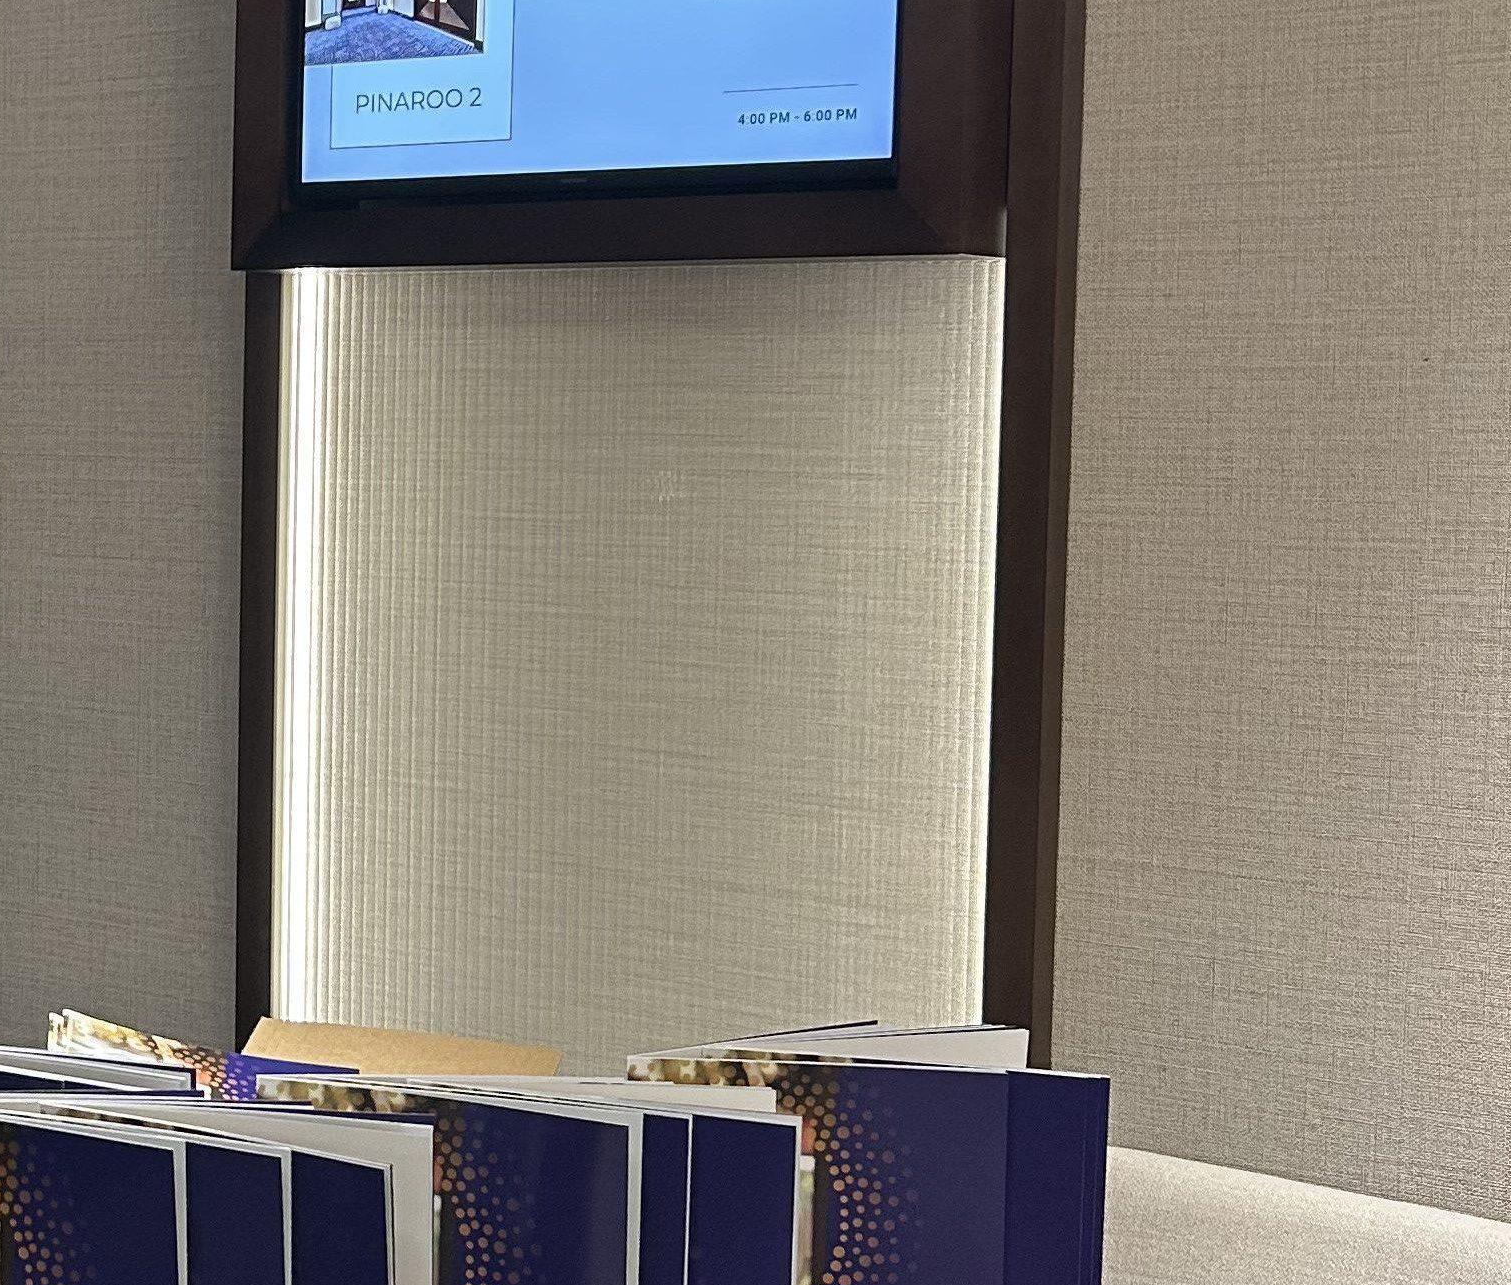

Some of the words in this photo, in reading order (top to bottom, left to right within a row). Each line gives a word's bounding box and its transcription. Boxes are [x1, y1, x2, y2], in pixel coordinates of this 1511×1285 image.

[355, 88, 463, 115] PINAROO
[469, 87, 483, 107] 2
[769, 111, 790, 124] PM
[835, 108, 857, 120] PM
